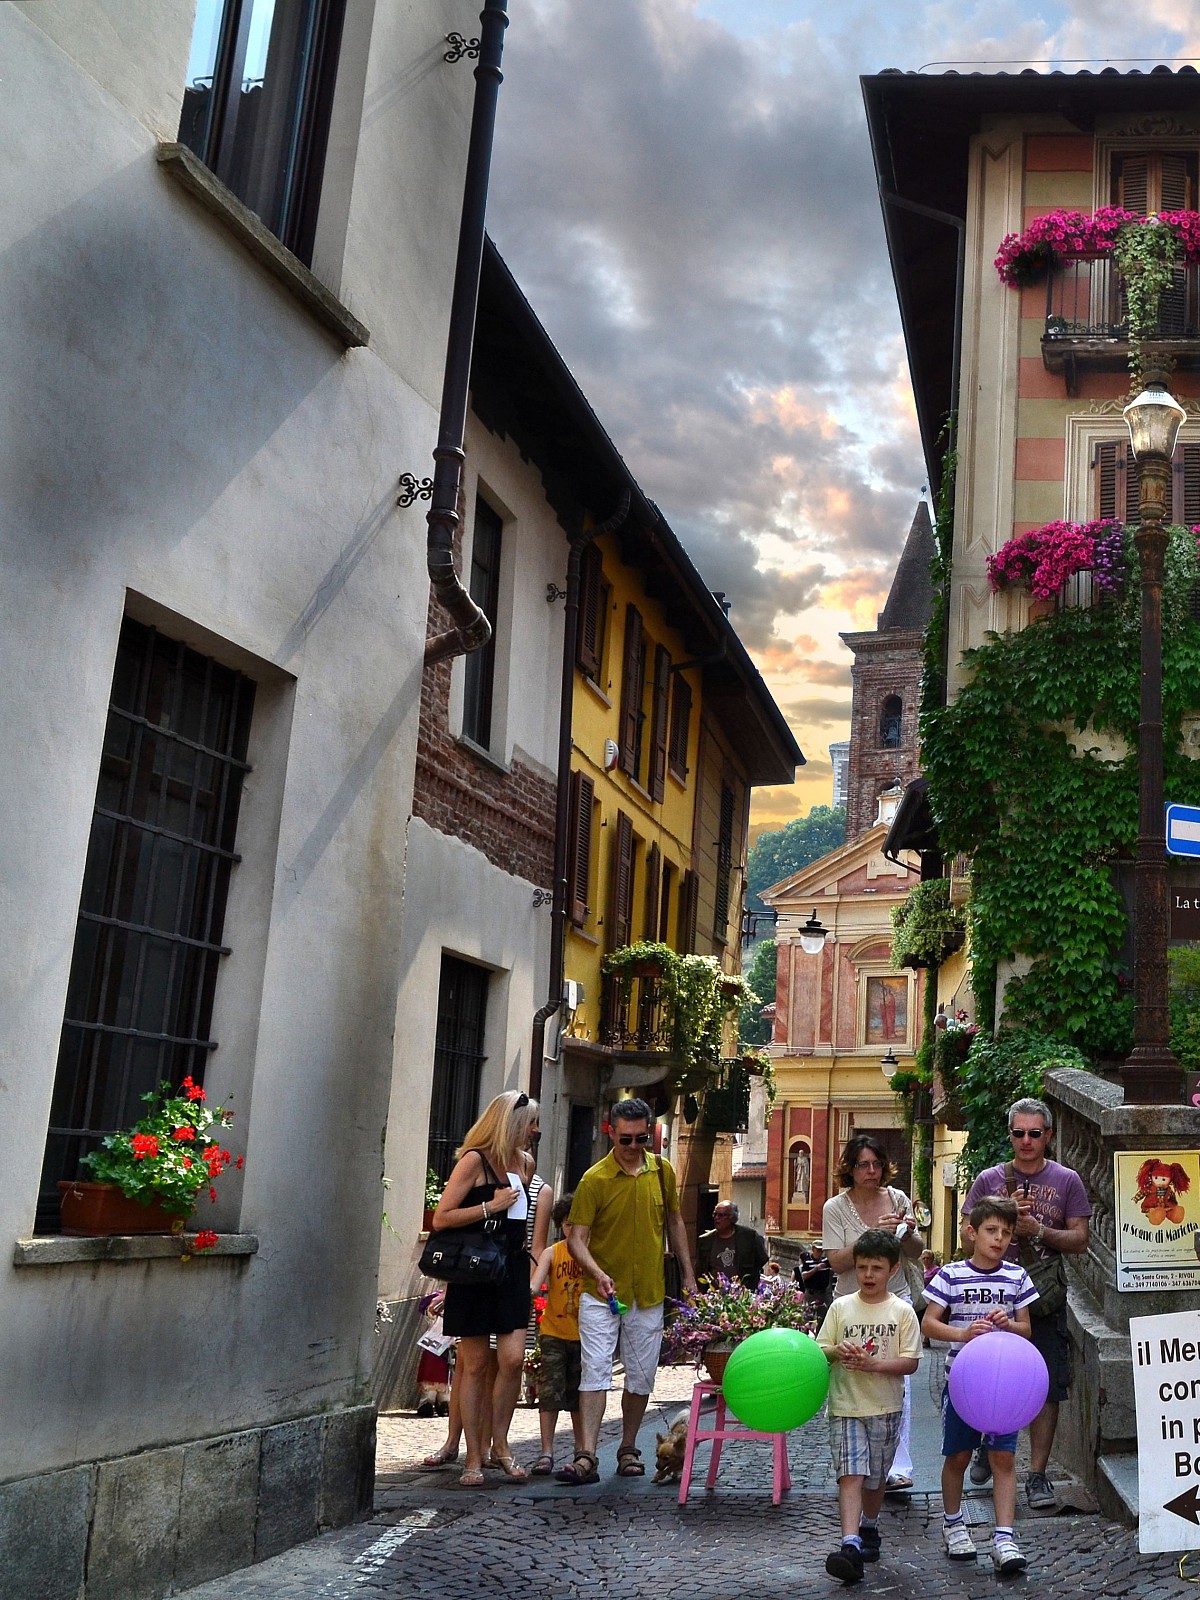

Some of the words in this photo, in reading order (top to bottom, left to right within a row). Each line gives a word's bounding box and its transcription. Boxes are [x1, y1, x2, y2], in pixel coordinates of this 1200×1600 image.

[1175, 896, 1190, 909] La
[1130, 1224, 1153, 1242] Sogno
[1155, 1229, 1164, 1243] di
[842, 1323, 898, 1339] ACTION
[1137, 1341, 1151, 1366] il
[1161, 1415, 1184, 1440] in
